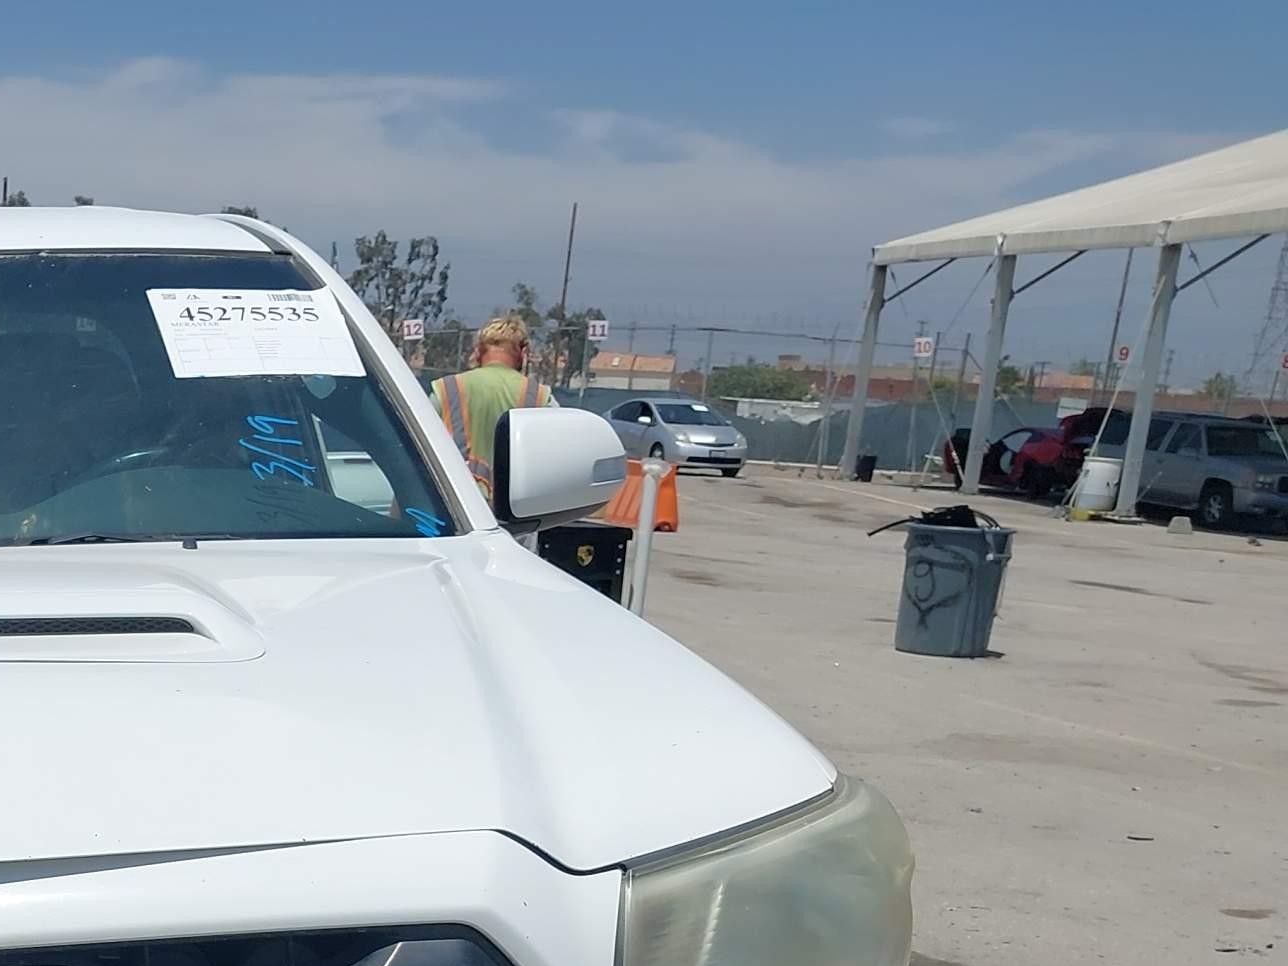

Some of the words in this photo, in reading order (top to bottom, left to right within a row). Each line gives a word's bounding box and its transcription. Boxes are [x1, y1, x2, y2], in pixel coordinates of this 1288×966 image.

[179, 306, 320, 322] 45275535
[405, 323, 422, 336] 12
[589, 324, 606, 337] 11
[914, 340, 932, 354] 10
[1119, 346, 1129, 361] 9
